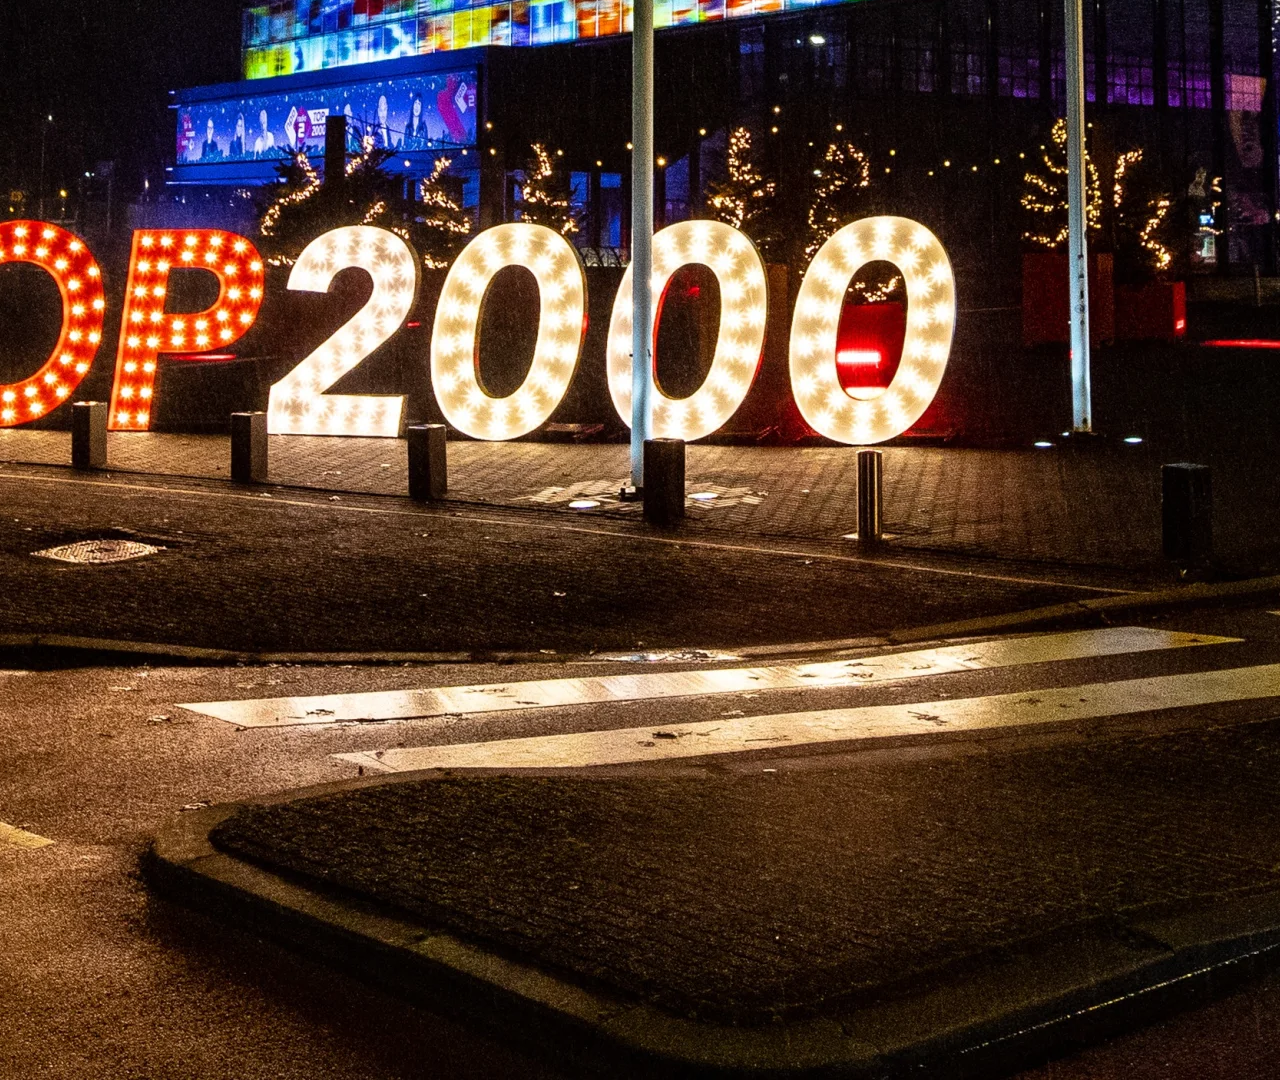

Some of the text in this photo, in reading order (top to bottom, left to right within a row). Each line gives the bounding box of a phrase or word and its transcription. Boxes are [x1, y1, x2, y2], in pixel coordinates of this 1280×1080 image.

[468, 95, 475, 107] 2
[313, 111, 326, 122] TOP
[298, 122, 305, 138] 2
[267, 216, 956, 445] 2000
